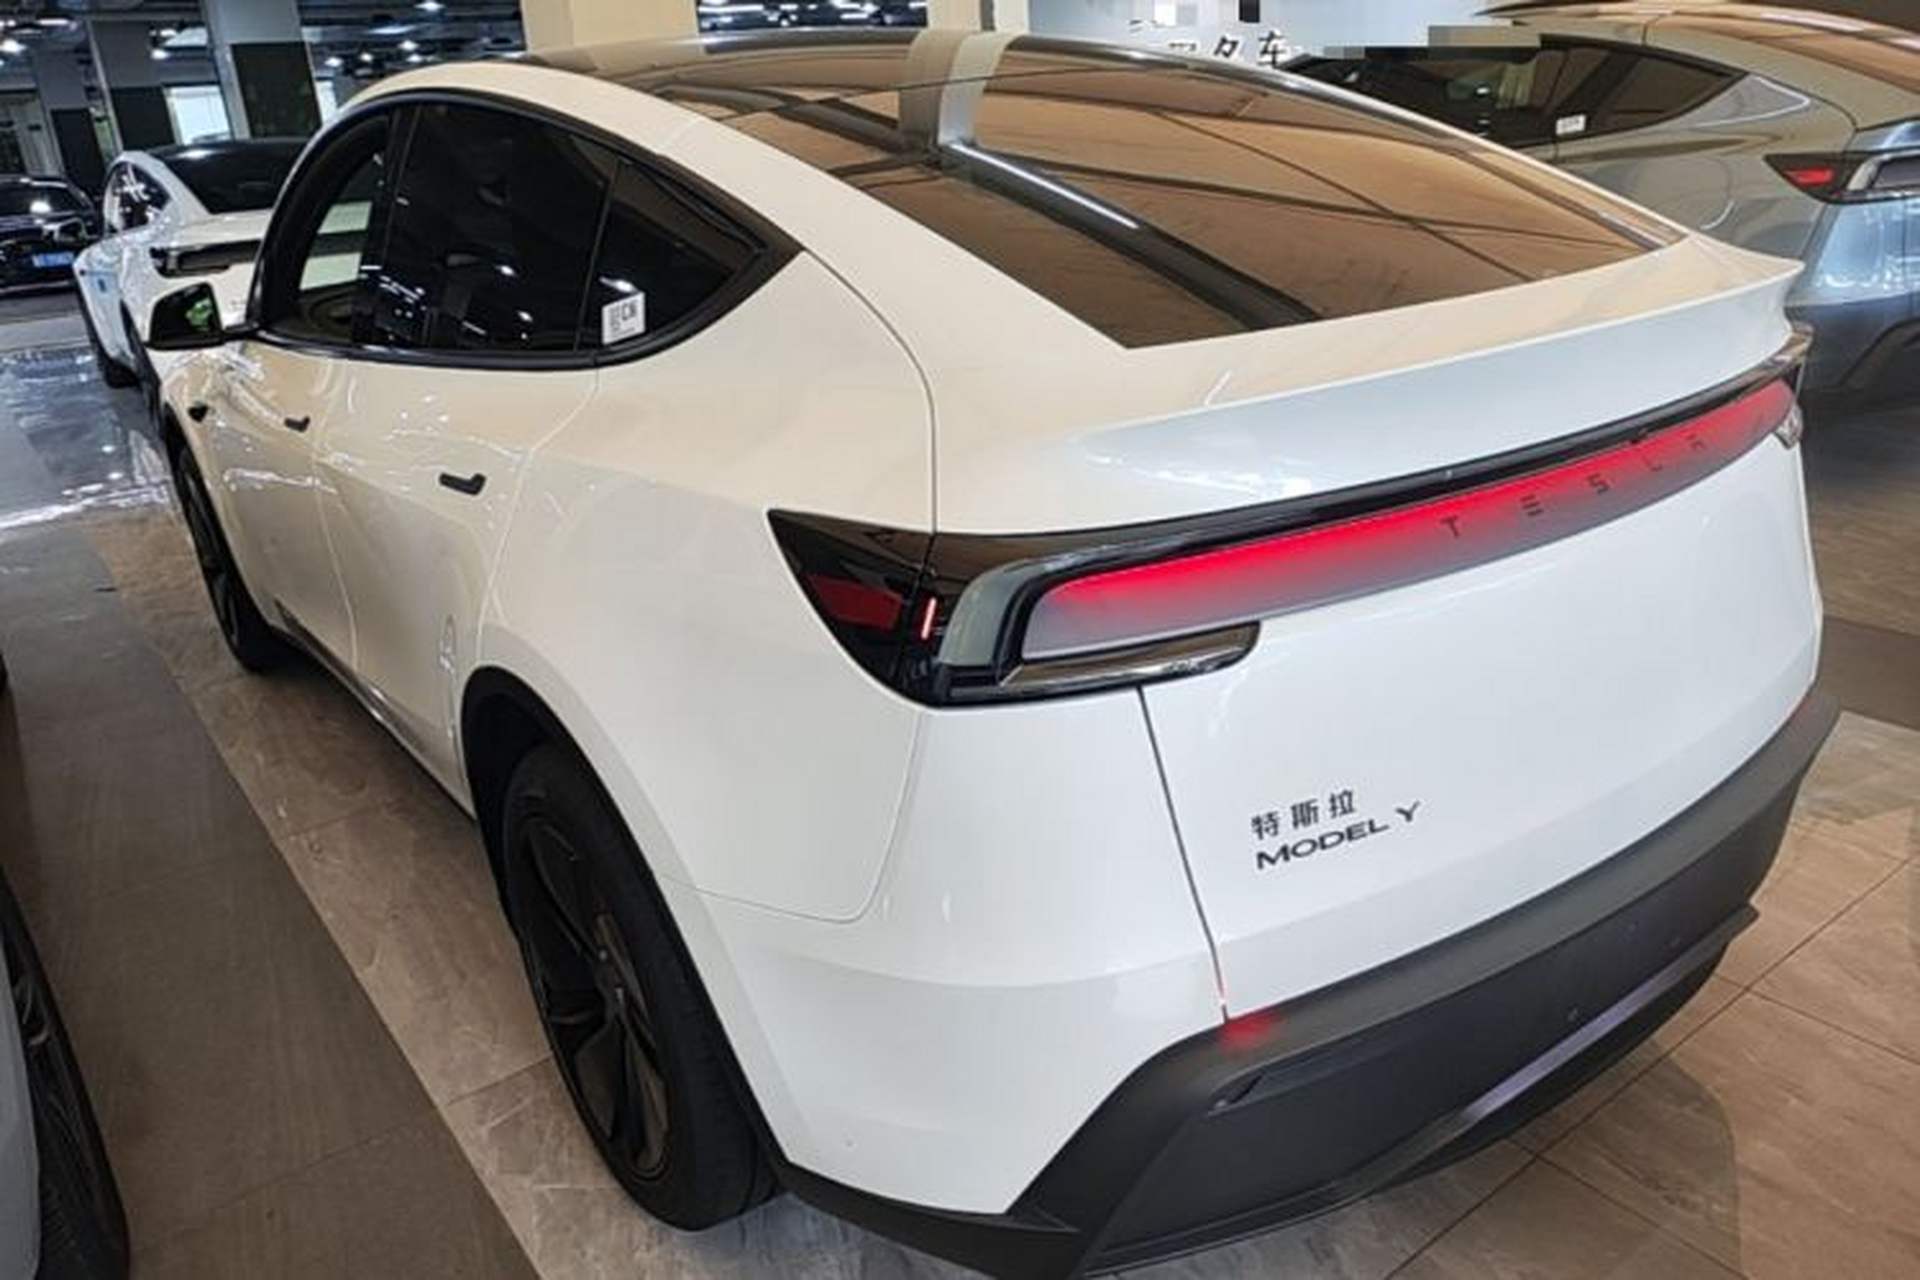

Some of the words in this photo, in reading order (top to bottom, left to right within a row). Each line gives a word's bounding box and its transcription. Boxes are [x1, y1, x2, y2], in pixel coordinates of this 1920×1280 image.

[1252, 790, 1355, 840] 特斯拉
[1257, 819, 1390, 869] MODEL
[1395, 801, 1420, 822] Y
